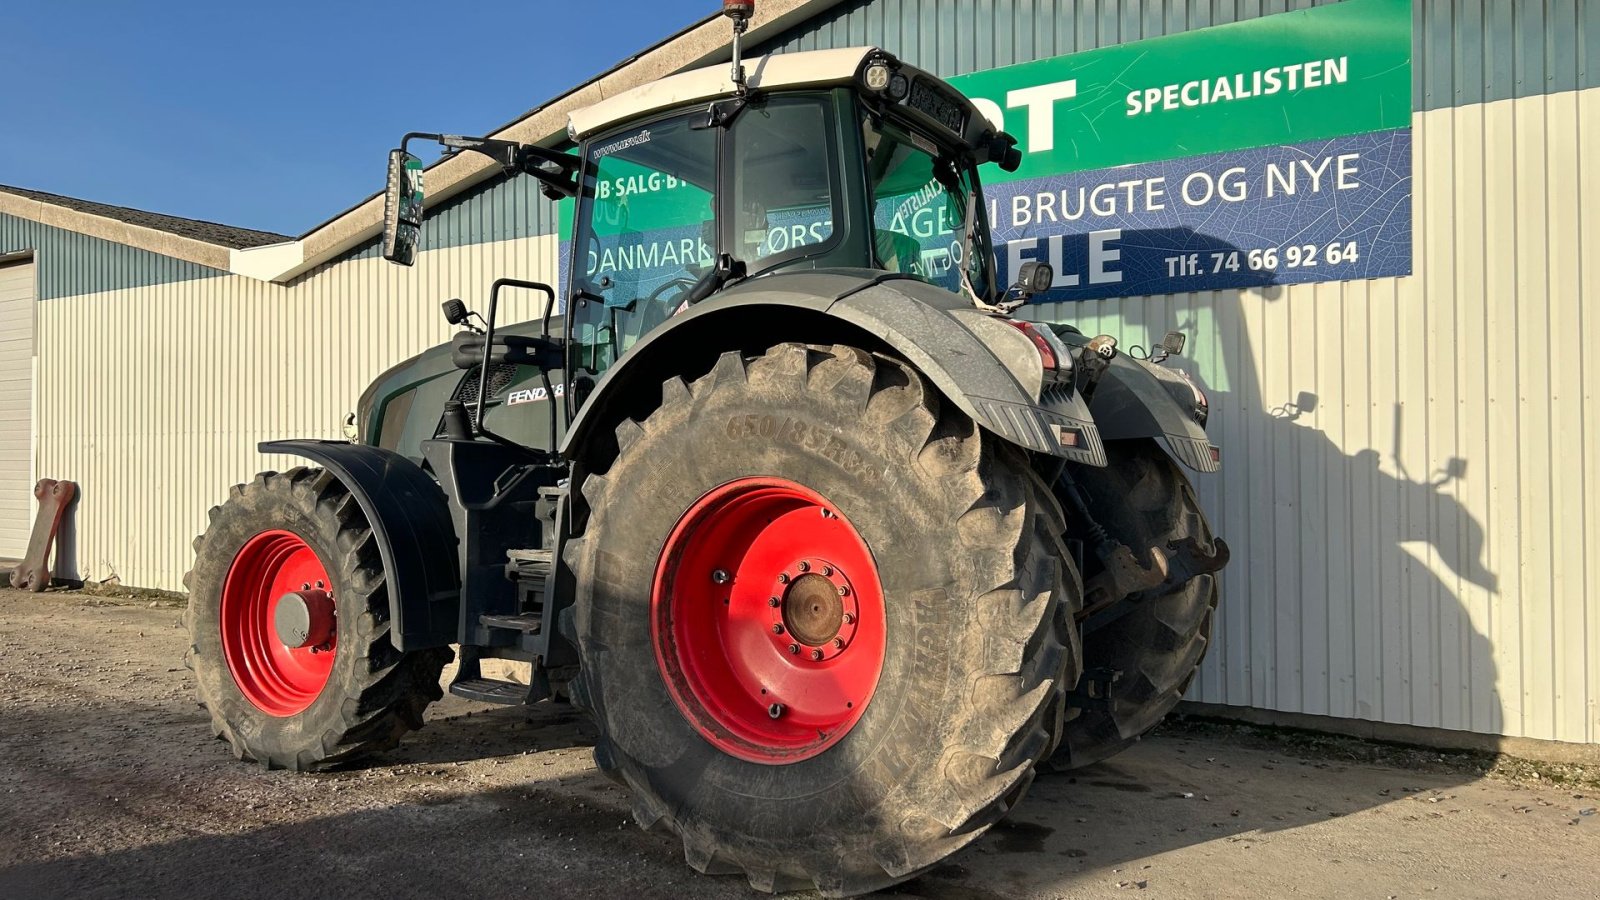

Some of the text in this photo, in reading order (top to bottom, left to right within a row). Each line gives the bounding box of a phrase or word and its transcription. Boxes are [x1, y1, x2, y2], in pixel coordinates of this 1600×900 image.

[1126, 56, 1348, 116] SPECIALISTEN
[1011, 177, 1166, 228] BRUGTE
[1181, 167, 1248, 206] OG
[1266, 153, 1360, 198] NYE
[1165, 241, 1360, 278] Tlf. 74 66 92 64
[507, 385, 554, 405] FEND
